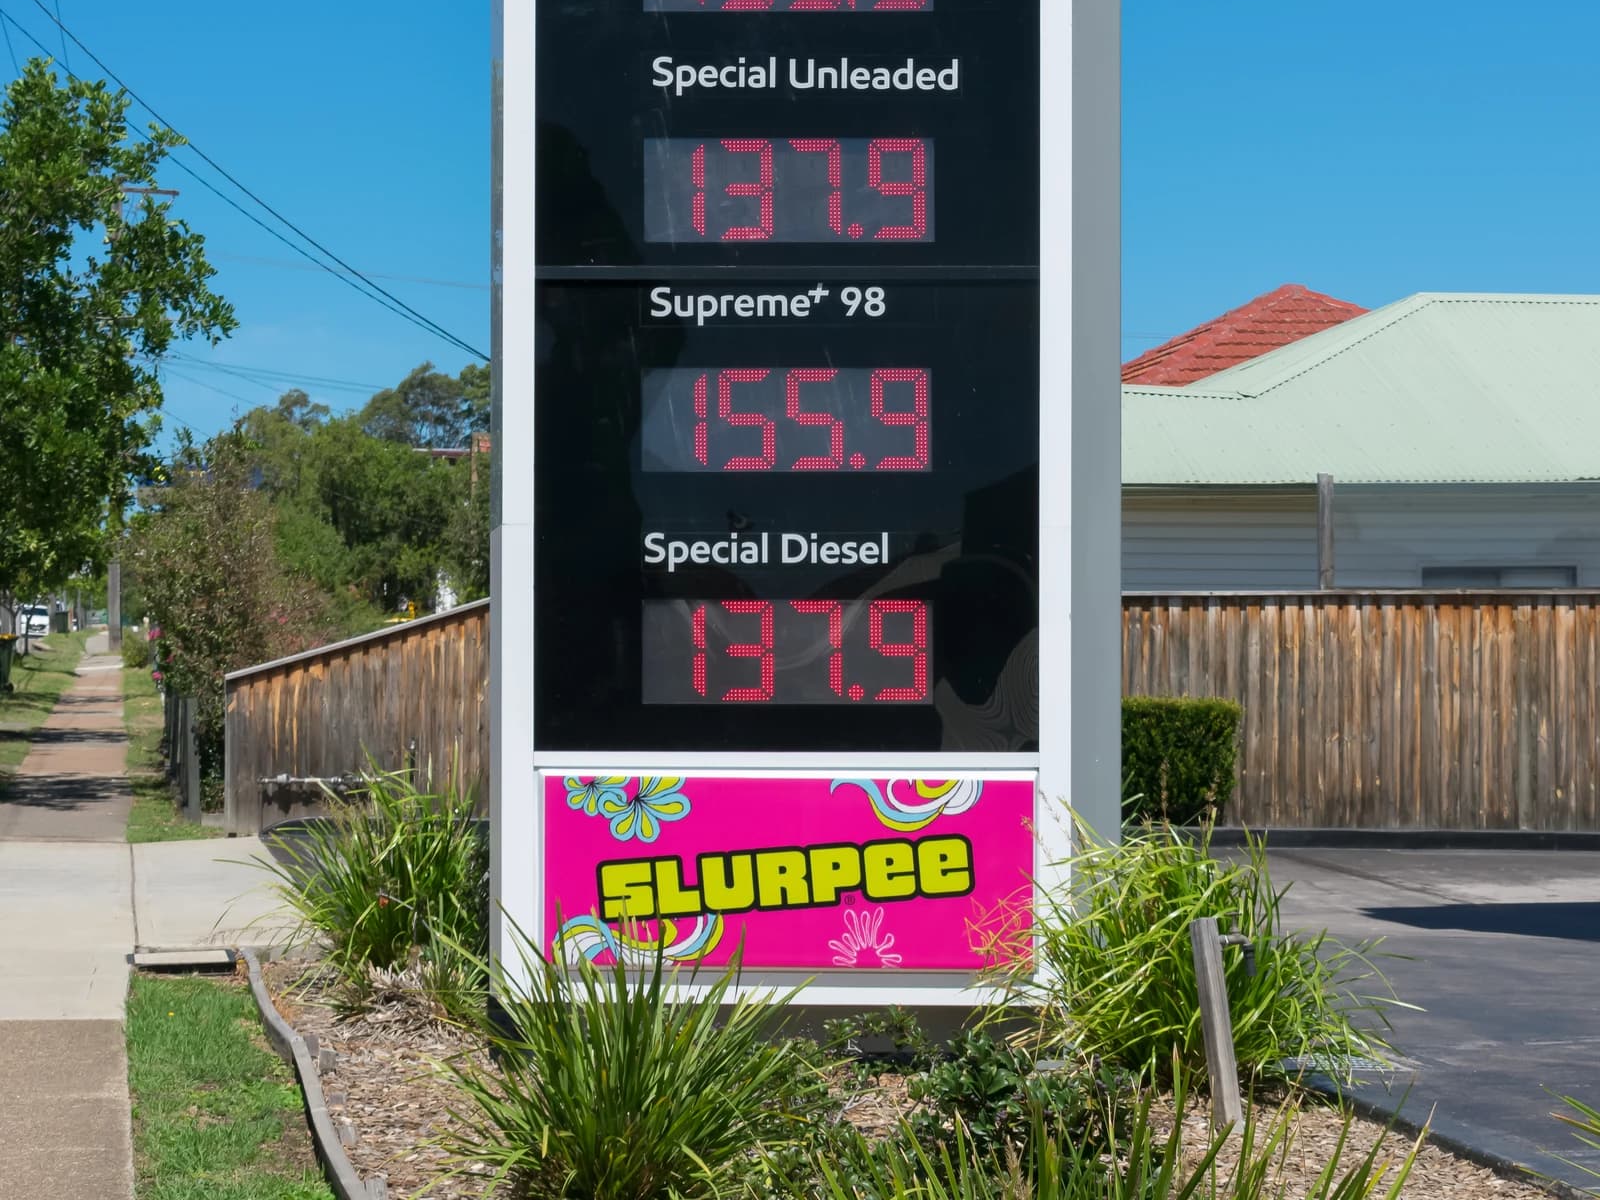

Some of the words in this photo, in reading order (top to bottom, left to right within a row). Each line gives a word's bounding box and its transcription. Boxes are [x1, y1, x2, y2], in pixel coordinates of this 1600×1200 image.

[651, 56, 777, 97] Special
[789, 57, 959, 91] Unleaded
[690, 138, 928, 241] 137.9
[840, 286, 886, 318] 98
[692, 368, 929, 471] 155.9
[644, 532, 769, 573] Special
[781, 531, 889, 565] Diesel
[690, 599, 928, 702] 137.9
